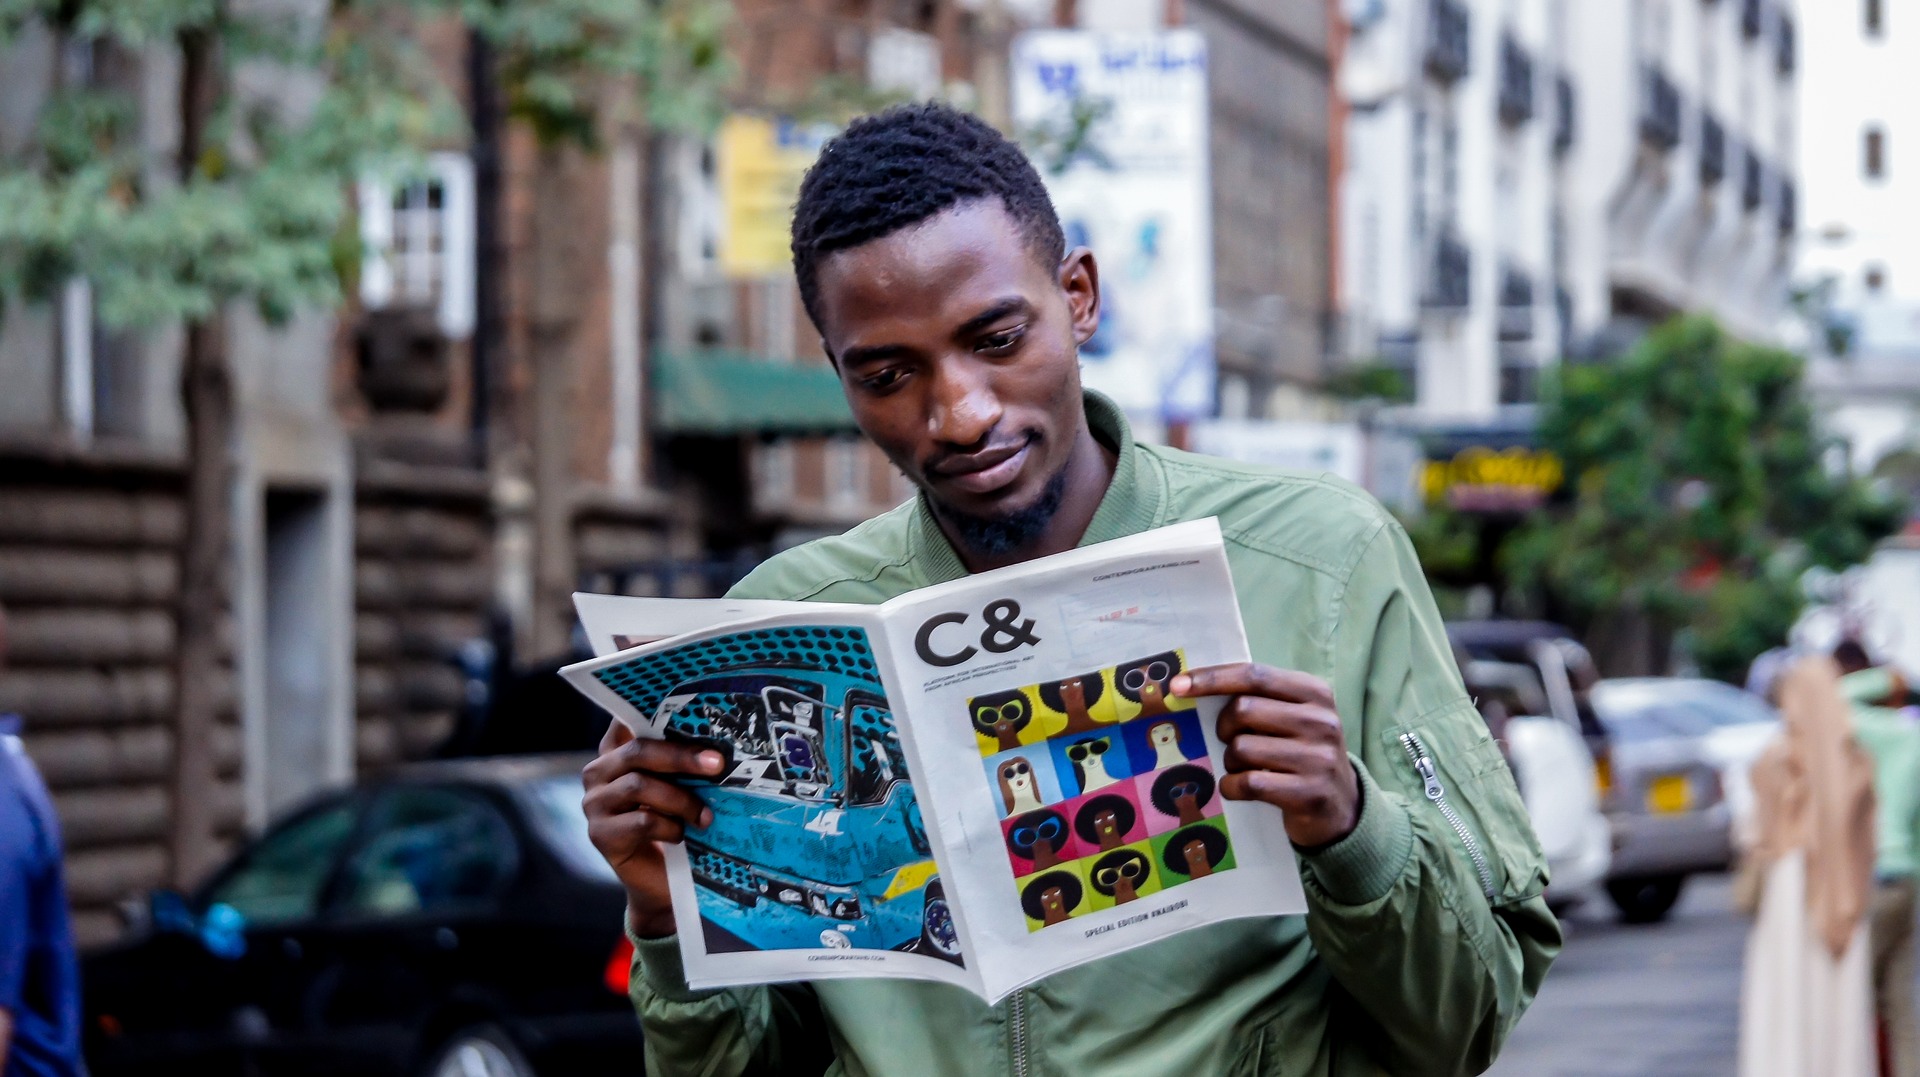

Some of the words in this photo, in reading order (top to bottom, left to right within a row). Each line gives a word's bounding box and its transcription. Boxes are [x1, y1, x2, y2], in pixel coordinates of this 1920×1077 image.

[914, 597, 1042, 667] C&
[971, 659, 1020, 674] INTERNATIONAL
[1022, 654, 1035, 662] ART
[924, 683, 942, 693] FROM
[1085, 923, 1115, 938] SPECIAL
[1118, 912, 1149, 928] EDITION
